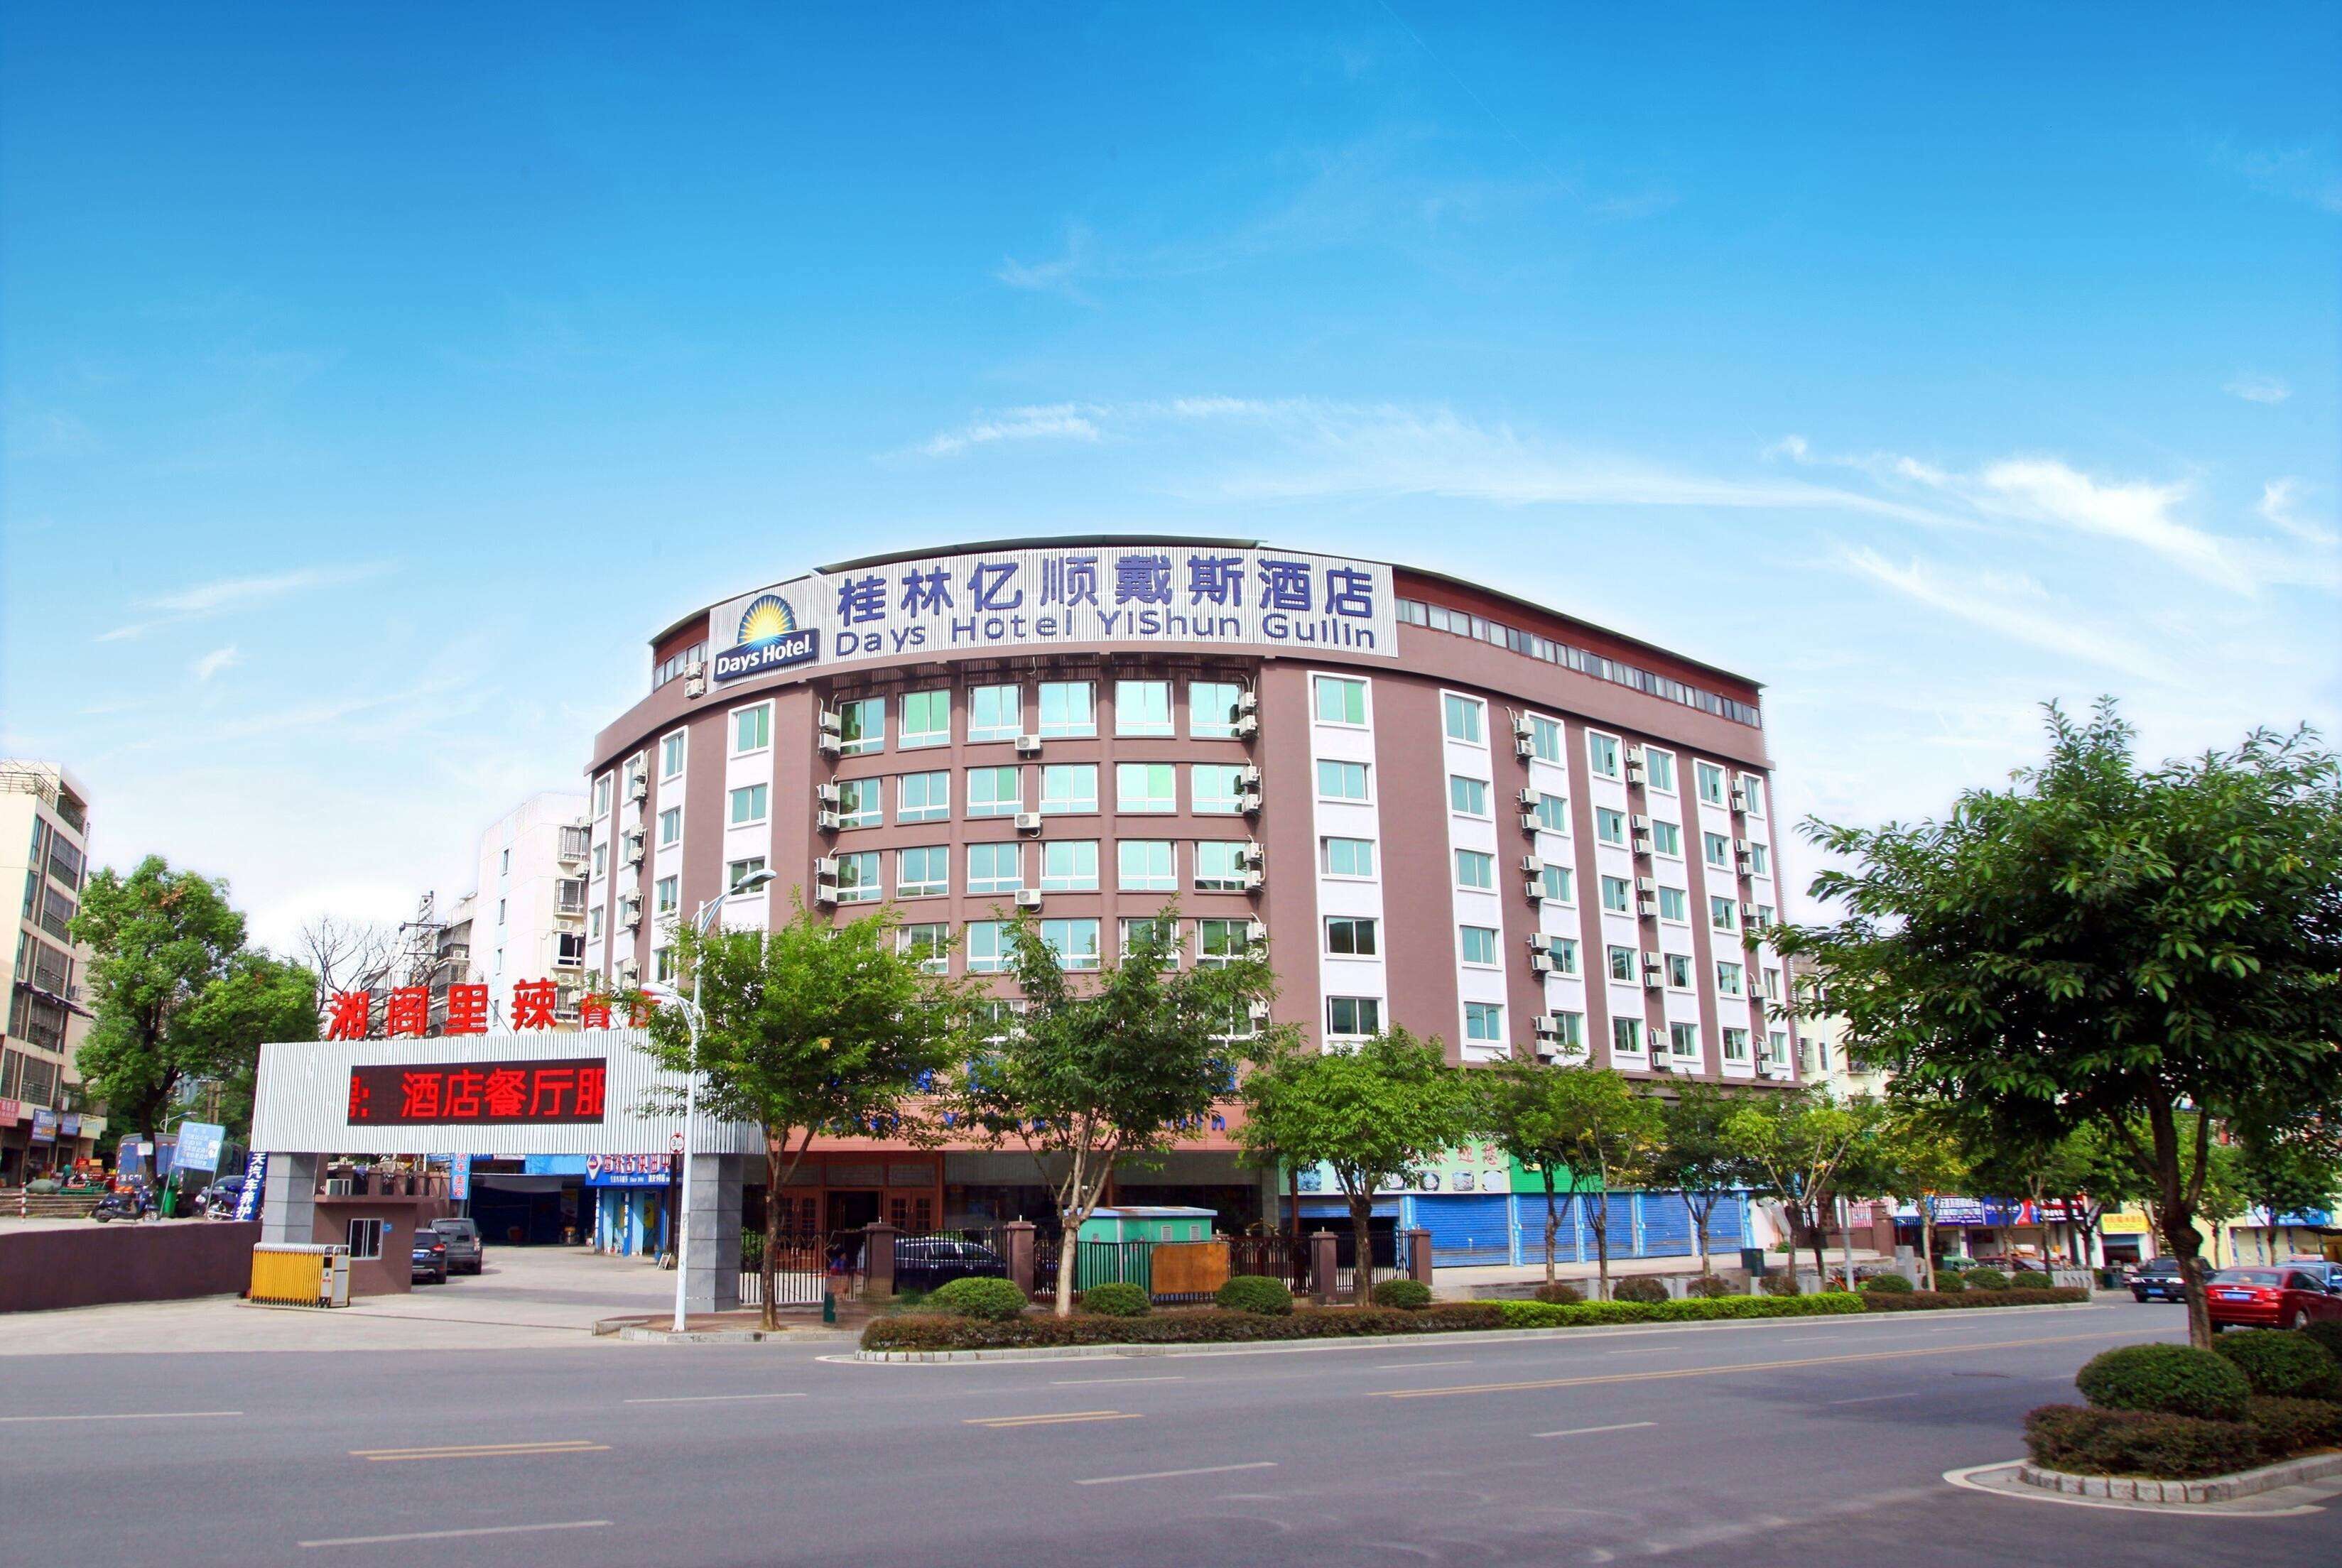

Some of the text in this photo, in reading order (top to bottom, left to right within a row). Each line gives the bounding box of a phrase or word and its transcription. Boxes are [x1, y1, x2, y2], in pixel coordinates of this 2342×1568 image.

[837, 555, 1372, 626] 桂林亿顺戴斯酒店
[835, 608, 1375, 656] Days Hotel YiShun Guilin
[717, 650, 760, 675] Days
